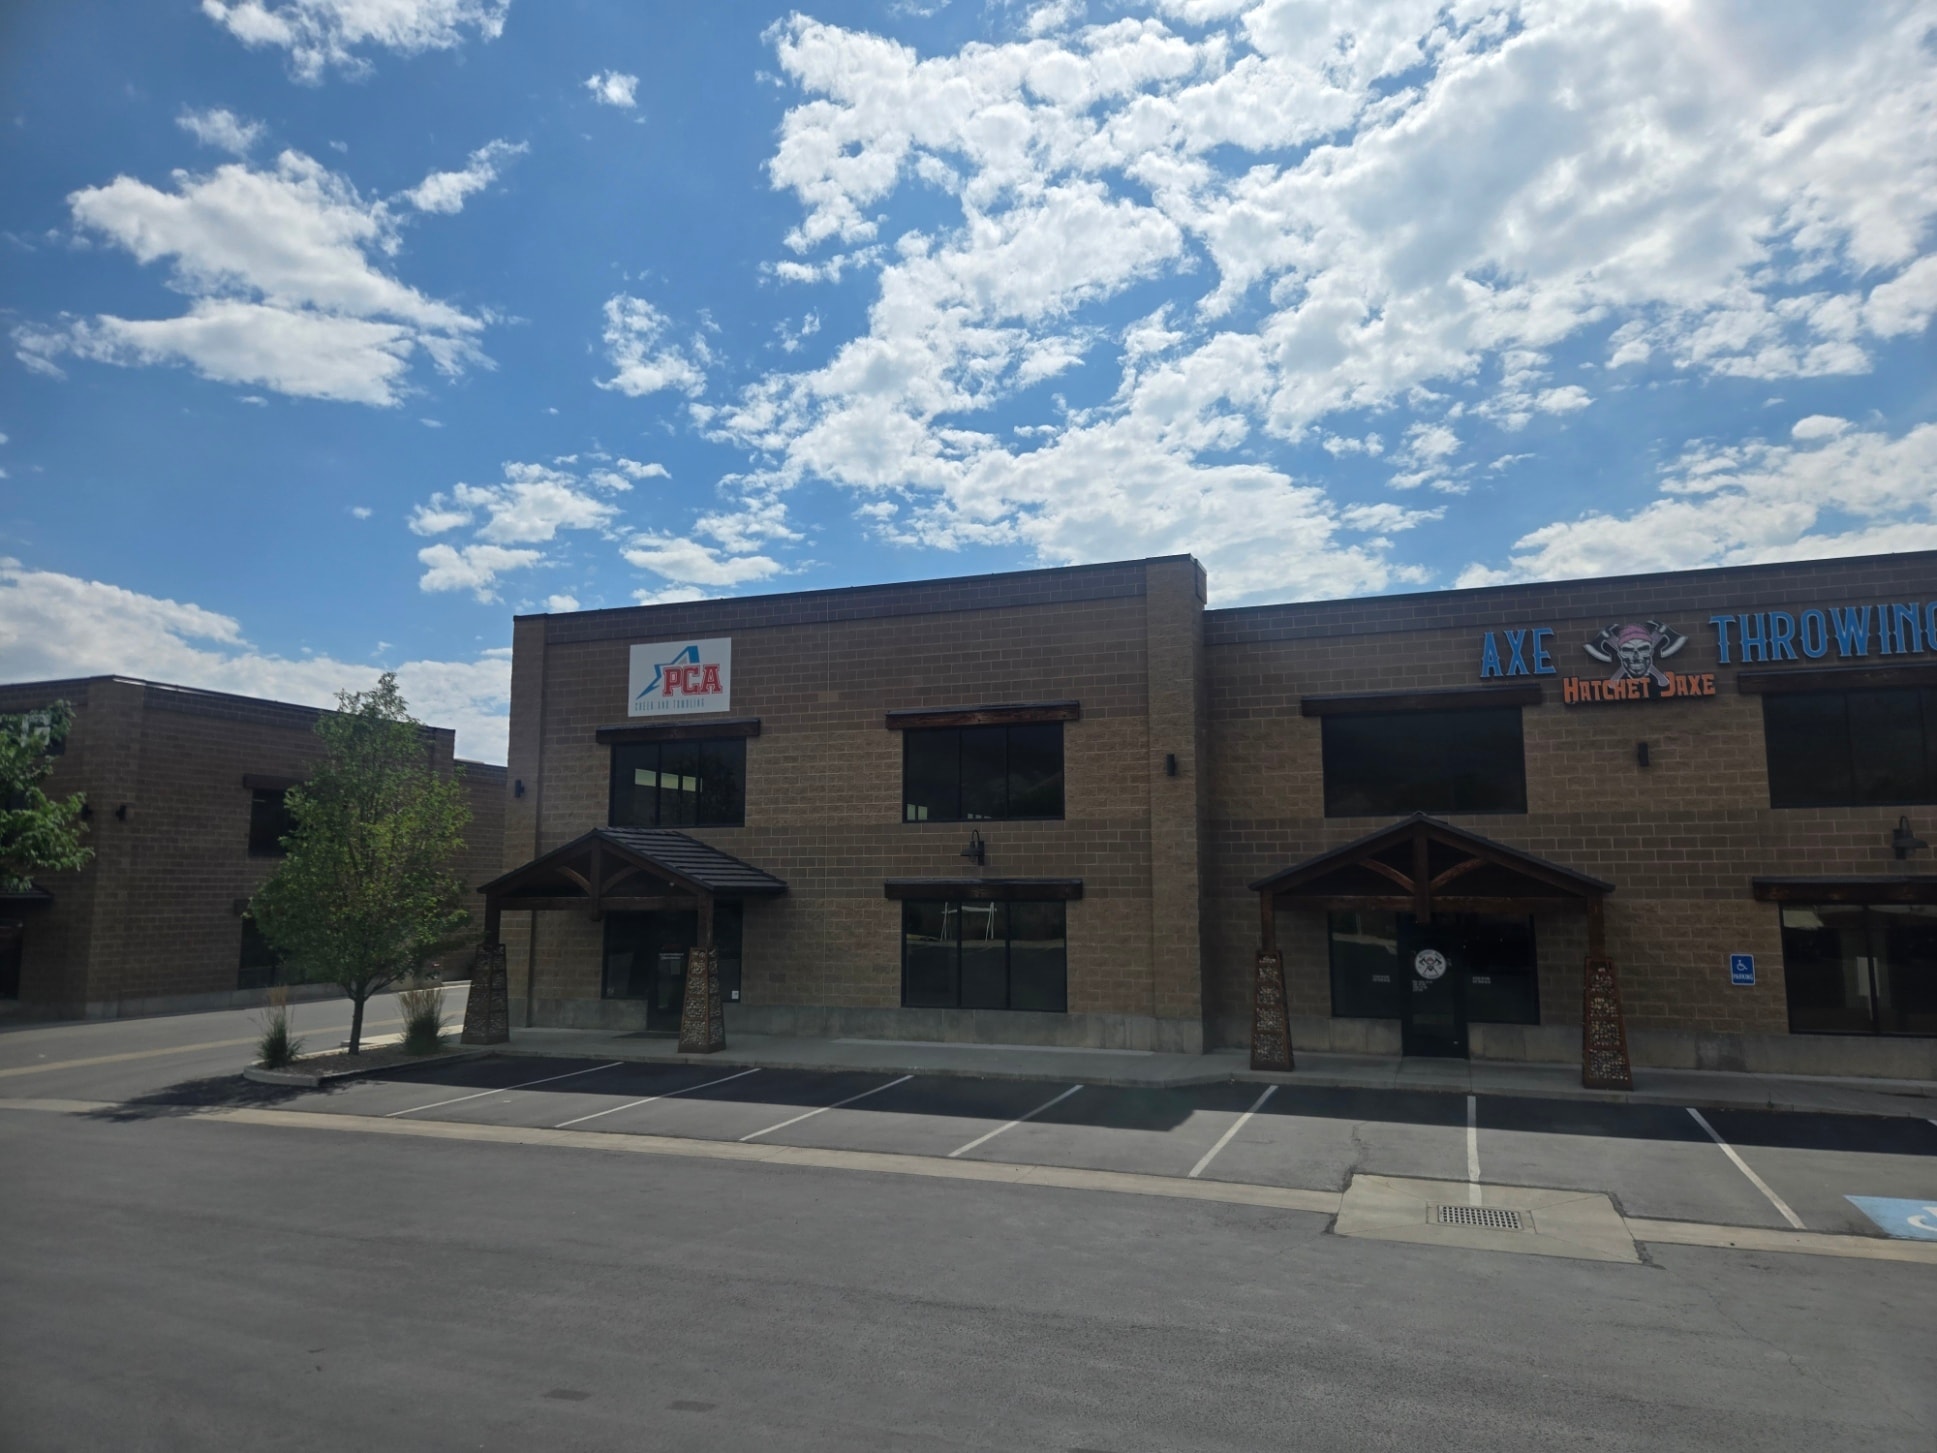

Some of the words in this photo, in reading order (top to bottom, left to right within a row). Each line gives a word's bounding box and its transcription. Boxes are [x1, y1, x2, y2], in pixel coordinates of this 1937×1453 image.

[1480, 627, 1557, 677] AXE
[662, 664, 723, 697] PCA
[1563, 677, 1650, 704] HATCHET
[1660, 671, 1716, 697] JAXE
